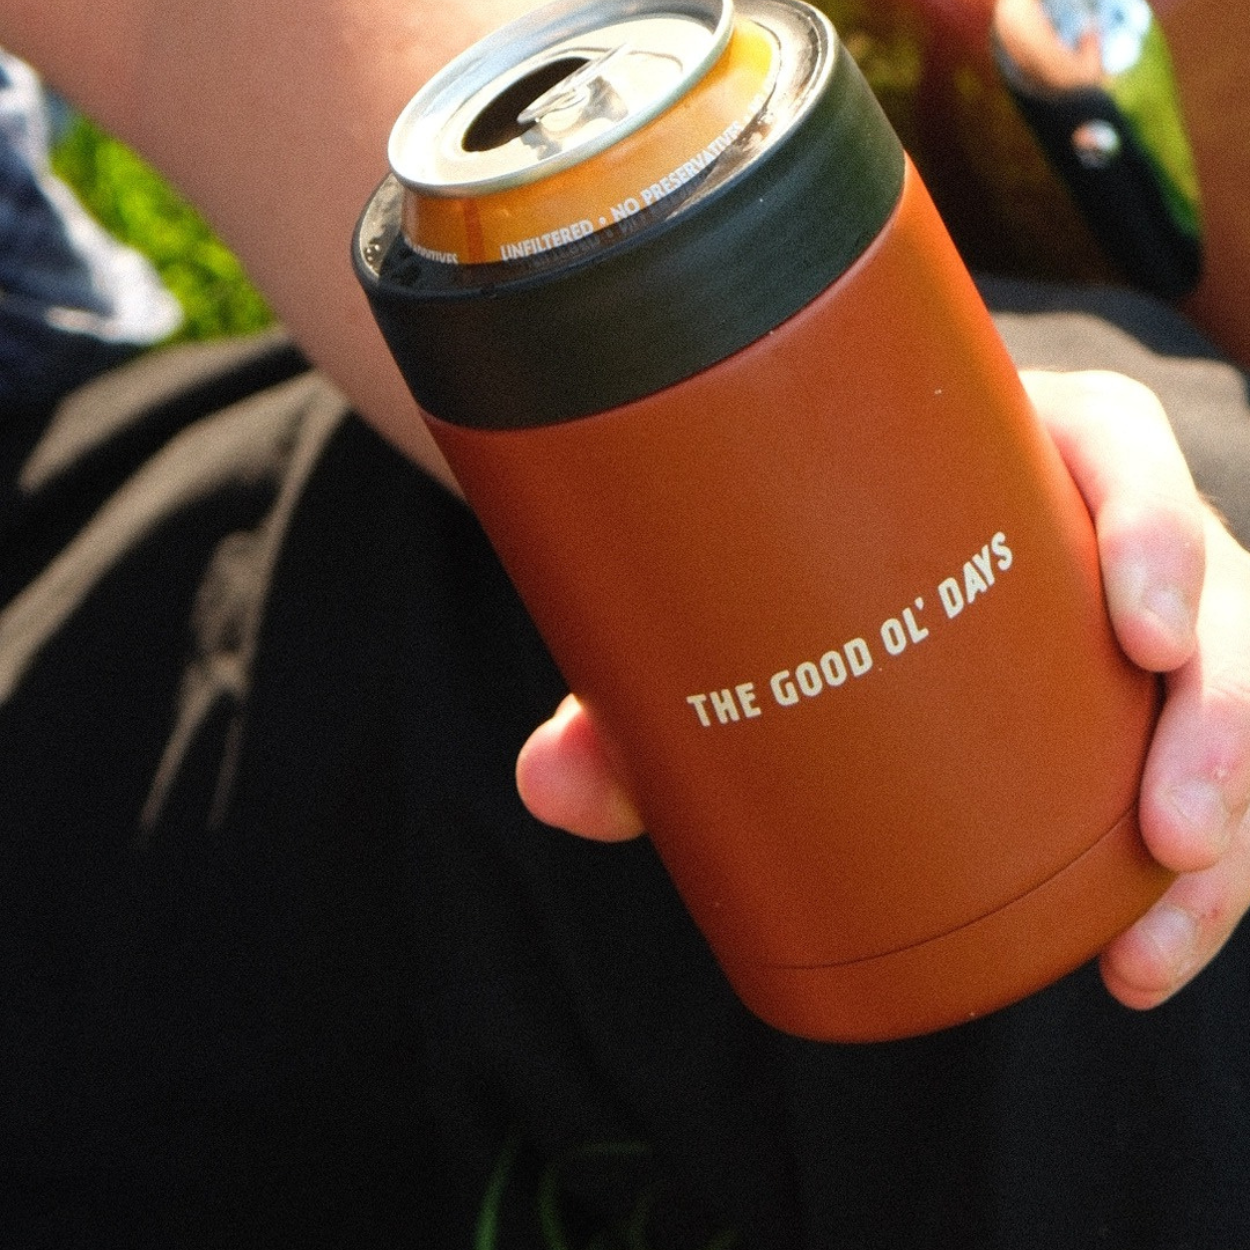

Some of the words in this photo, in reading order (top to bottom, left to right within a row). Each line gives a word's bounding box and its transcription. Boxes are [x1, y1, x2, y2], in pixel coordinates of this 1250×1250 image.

[499, 219, 594, 262] UNFILTERED
[609, 197, 640, 223] NO
[639, 120, 744, 207] PRESERVATIVES
[686, 681, 763, 728] THE
[769, 637, 874, 707] GOOD
[879, 596, 930, 656] OL'
[937, 530, 1014, 620] DAYS
